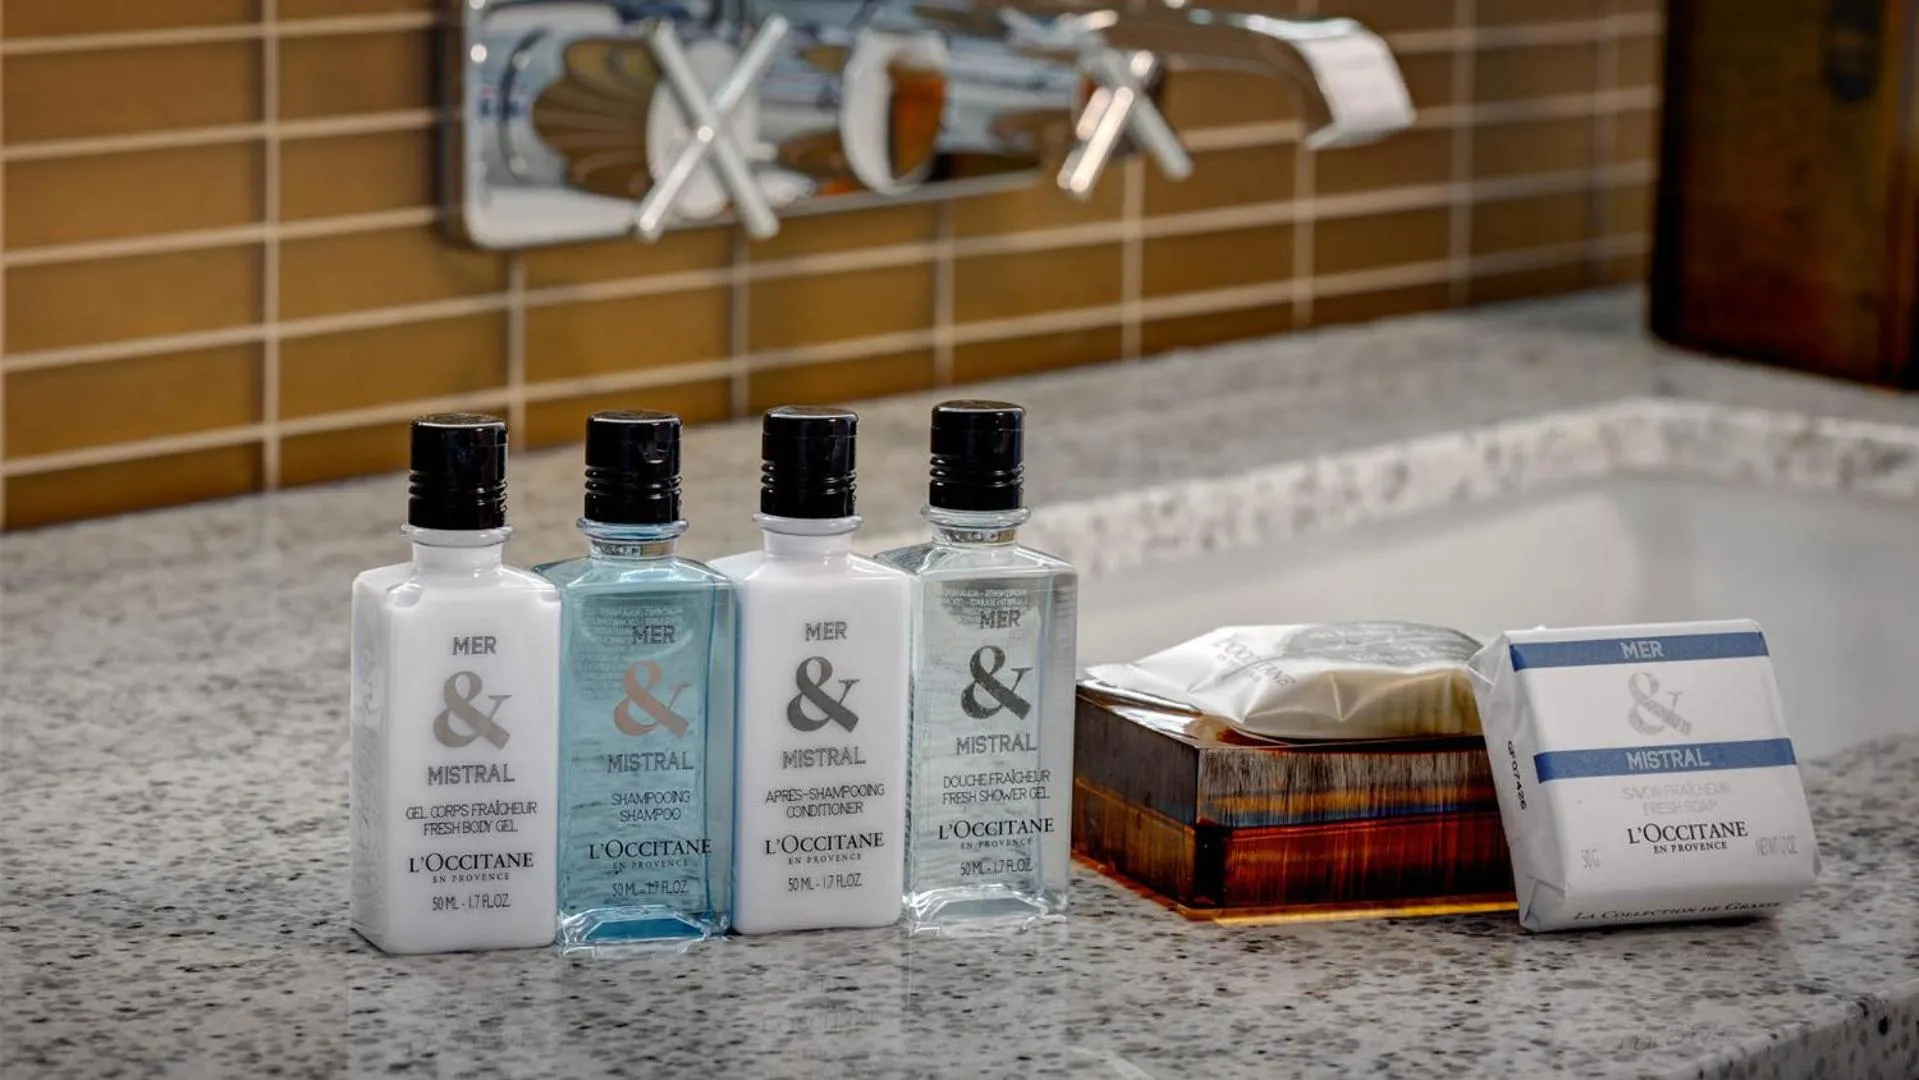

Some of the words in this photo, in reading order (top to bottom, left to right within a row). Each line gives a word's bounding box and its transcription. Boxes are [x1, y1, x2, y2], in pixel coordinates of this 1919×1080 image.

[980, 609, 1021, 629] MER
[631, 625, 676, 645] MER
[805, 621, 848, 641] MER
[452, 635, 497, 656] MER
[1620, 640, 1664, 659] MER
[961, 645, 1033, 720] &
[613, 660, 692, 739] &
[786, 656, 861, 733] &
[1627, 670, 1693, 737] &
[433, 670, 513, 751] &
[956, 732, 1038, 755] MISTRAL
[607, 751, 694, 773] MISTRAL
[782, 745, 867, 769] MISTRAL
[1625, 748, 1711, 770] MISTRAL
[427, 763, 516, 786] MISTRAL
[943, 772, 987, 789] DOUCHE
[612, 790, 691, 806] SHAMPOOING
[942, 790, 976, 805] FRESH
[979, 787, 1027, 802] SHOWER
[1029, 786, 1050, 800] GEL
[406, 806, 427, 820] GEL
[430, 803, 469, 819] CORPS
[620, 807, 682, 823] SHAMPOO
[786, 801, 864, 818] CONDITIONER
[423, 821, 460, 836] FRESH
[462, 819, 491, 834] BODY
[495, 819, 518, 832] GEL
[938, 817, 1054, 840] L'OCCITANE
[1627, 821, 1749, 845] L'OCCITANE
[589, 838, 712, 859] L'OCCITANE
[765, 831, 885, 855] L'OCCITANE
[978, 837, 1032, 849] PROVENCE
[1653, 845, 1668, 854] EN
[1671, 841, 1728, 853] PROVENCE
[408, 852, 534, 873] L'OCCITANE
[632, 859, 689, 869] PROVENCE
[788, 857, 801, 865] EN
[806, 853, 862, 864] PROVENCE
[432, 875, 446, 884] EN
[452, 872, 511, 882] PROVENCE
[801, 876, 814, 891] ML
[432, 896, 444, 911] 50
[446, 895, 460, 910] ML
